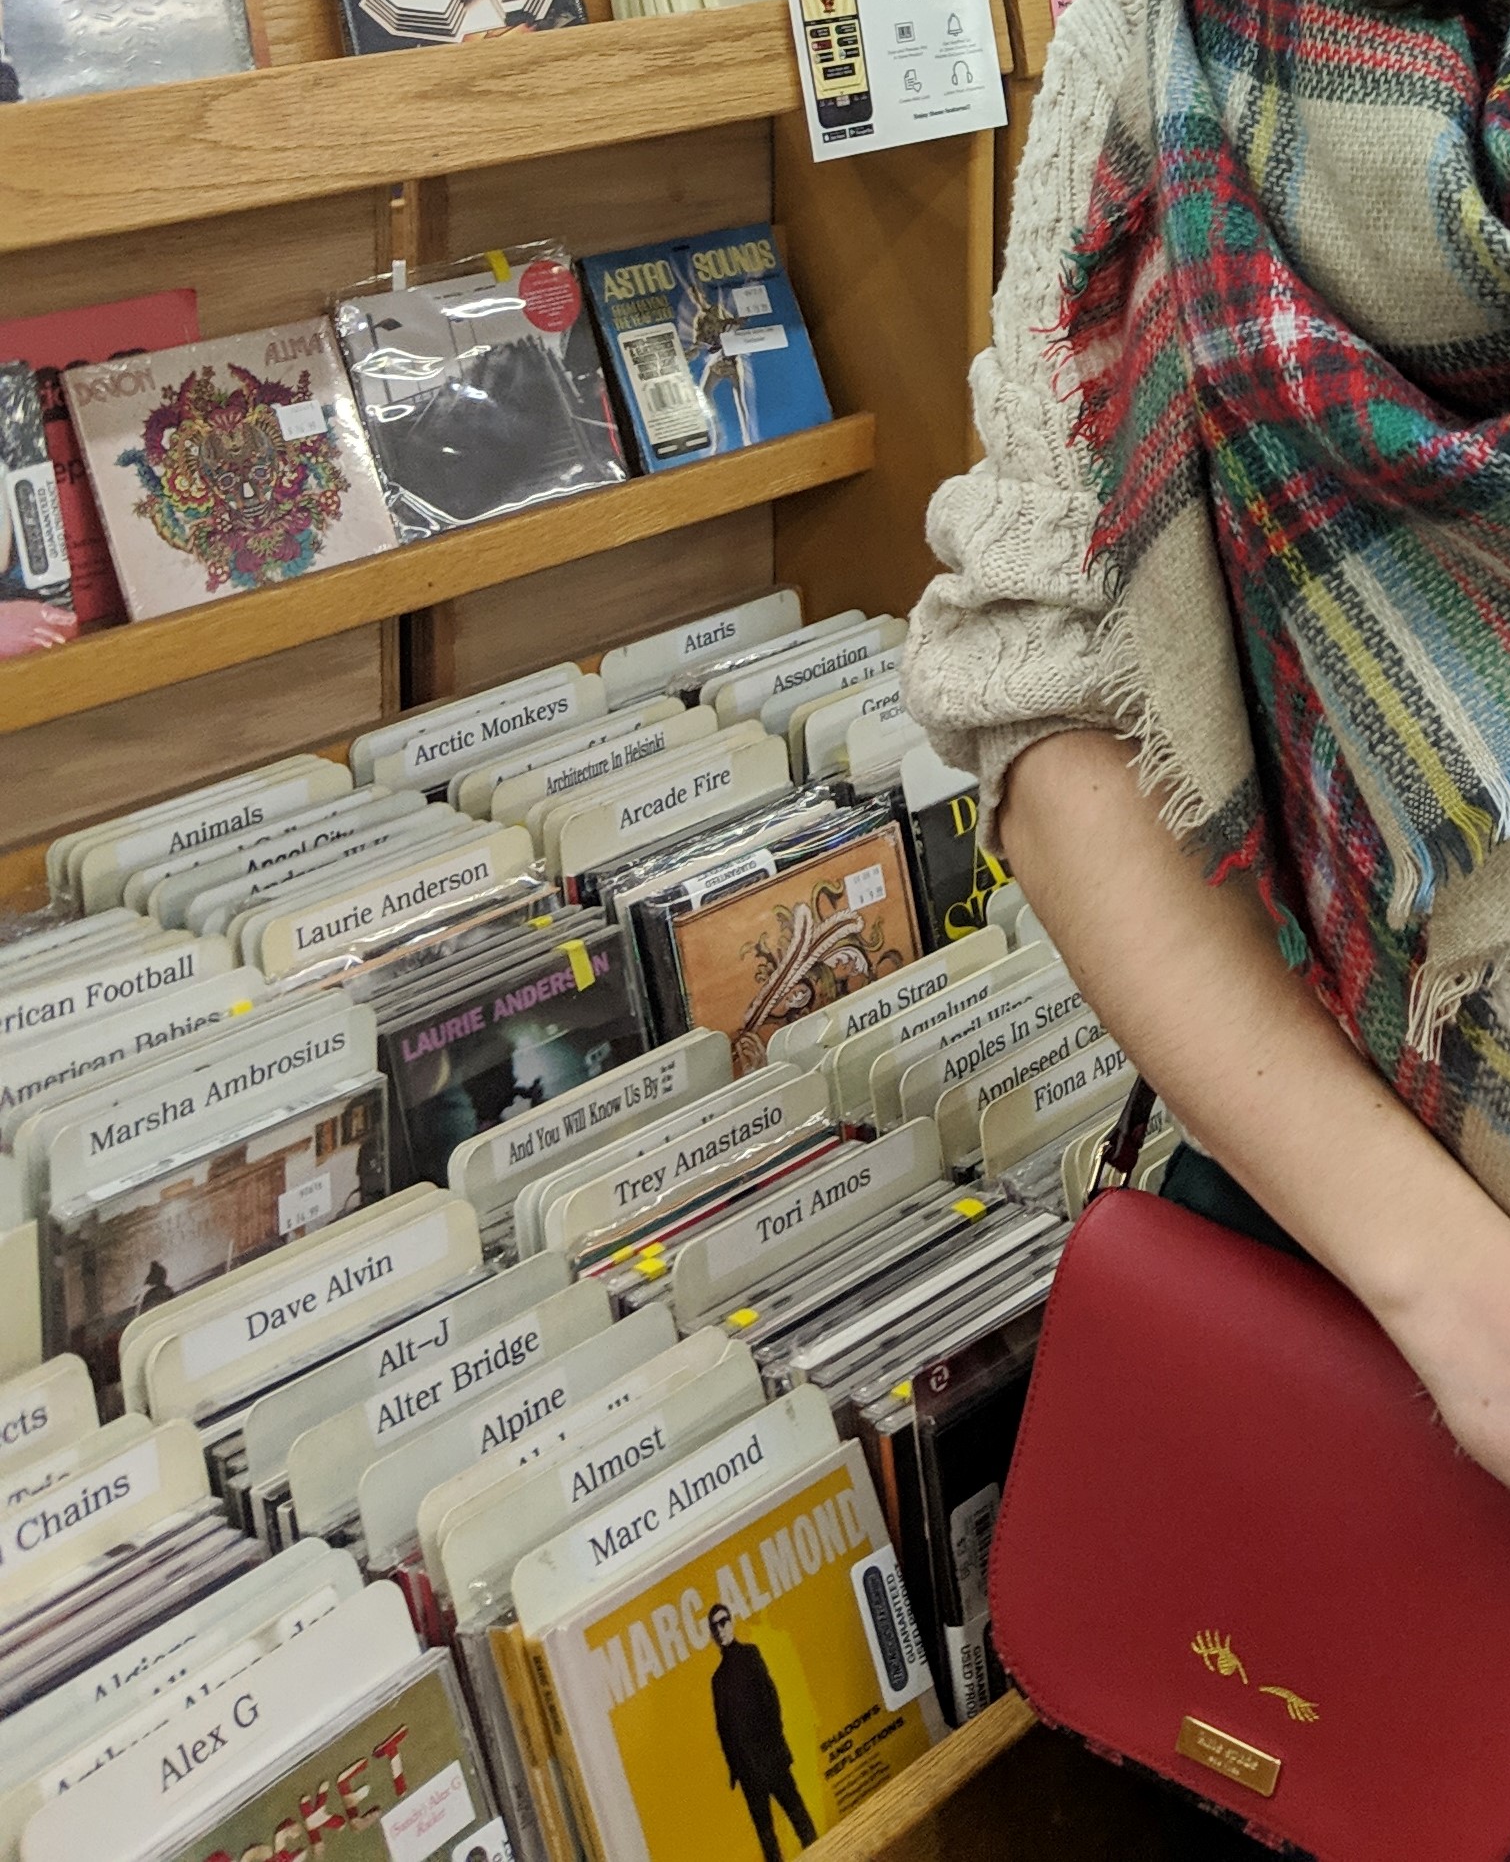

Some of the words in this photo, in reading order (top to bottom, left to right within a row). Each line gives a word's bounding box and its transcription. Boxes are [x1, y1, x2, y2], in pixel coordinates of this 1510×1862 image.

[602, 257, 678, 302] ASTRO
[692, 238, 778, 284] SOUNDS
[682, 619, 738, 655] Ataris
[771, 643, 870, 696] Association
[412, 727, 476, 767] Arctic
[481, 694, 570, 742] Monkeys
[544, 752, 608, 797] Architecture
[610, 749, 625, 771] In
[624, 731, 667, 766] Helsinki
[168, 803, 265, 856] Animals
[618, 786, 689, 830] Arcade
[692, 764, 732, 801] Fire
[296, 903, 375, 950] Laurie
[380, 859, 491, 921] Anderson
[85, 954, 195, 1011] Football
[402, 1003, 487, 1063] LAURIE
[491, 951, 611, 1023] ANDERSN
[844, 999, 893, 1037] Arab
[893, 970, 950, 1018] Strap
[941, 1032, 1007, 1084] Apples
[1009, 1020, 1031, 1045] In
[975, 1036, 1070, 1109] Appleseed
[88, 1095, 196, 1157] Marsha
[204, 1029, 347, 1107] Ambrosius
[507, 1136, 535, 1166] And
[536, 1123, 560, 1153] You
[562, 1109, 588, 1139] Will
[588, 1092, 623, 1123] Know
[623, 1082, 643, 1105] Us
[642, 1075, 661, 1103] By
[1033, 1069, 1088, 1113] Fiona
[613, 1169, 667, 1209] Trey
[672, 1105, 784, 1176] Anastasio
[755, 1198, 804, 1244] Tori
[805, 1166, 873, 1214] Amos
[245, 1290, 319, 1342] Dave
[326, 1251, 394, 1305] Alvin
[375, 1380, 443, 1435] Alter
[450, 1328, 541, 1394] Bridge
[376, 1317, 452, 1379] Alt-J
[480, 1386, 568, 1456] Alpine
[569, 1424, 667, 1505] Almost
[15, 1470, 132, 1552] Chains
[588, 1507, 660, 1567] Marc
[666, 1439, 766, 1513] Almond
[594, 1588, 712, 1708] MARC
[720, 1484, 870, 1624] ALMOND
[887, 1573, 915, 1666] GUARANTEED
[961, 1644, 974, 1681] USED
[159, 1720, 229, 1795] Alex
[232, 1692, 261, 1731] G
[819, 1703, 882, 1755] SHADOWS
[823, 1715, 906, 1781] REFLECTIONS
[828, 1738, 854, 1764] AND
[203, 1722, 410, 1862] CKET
